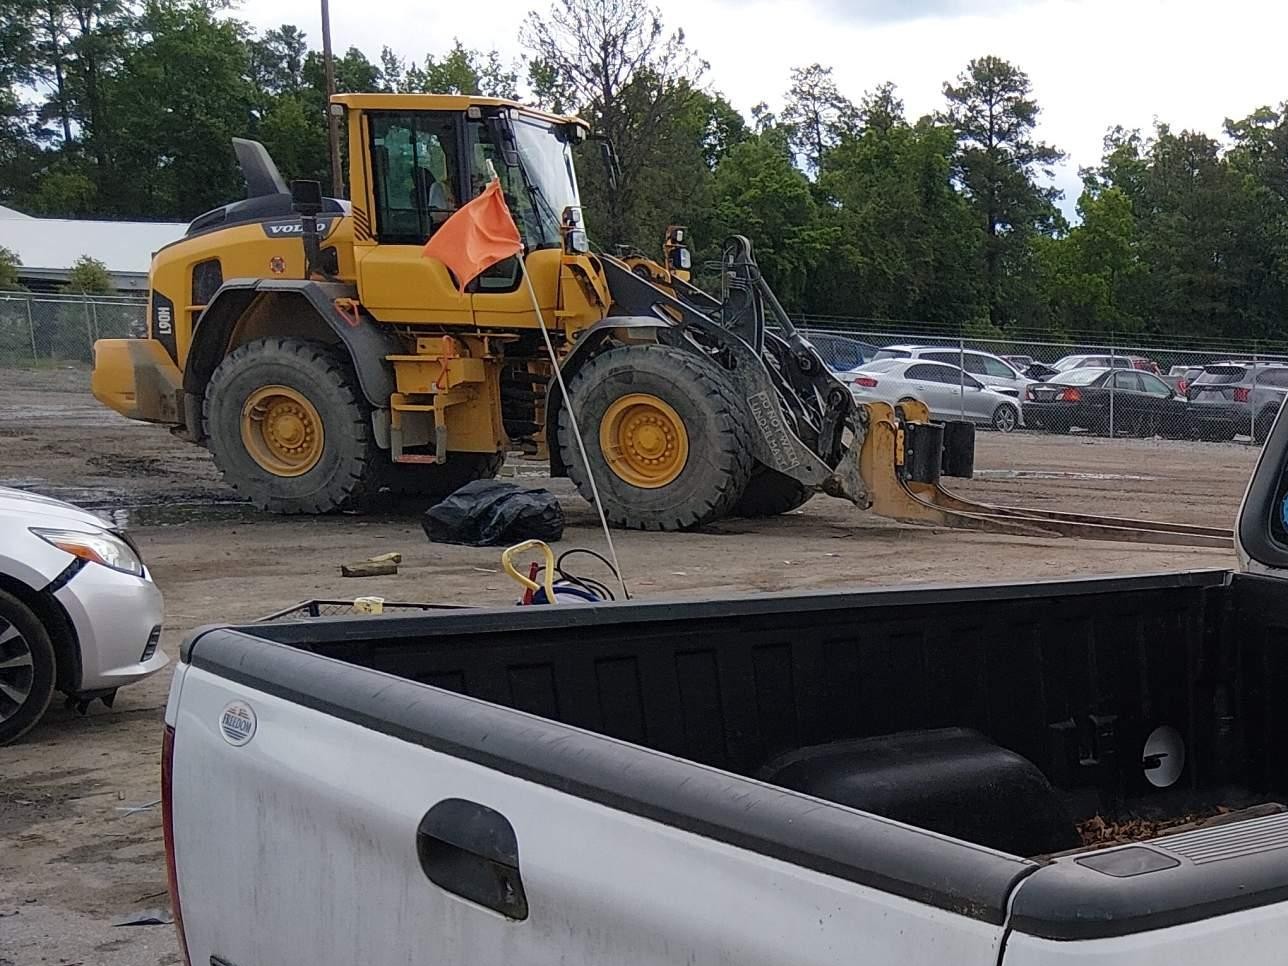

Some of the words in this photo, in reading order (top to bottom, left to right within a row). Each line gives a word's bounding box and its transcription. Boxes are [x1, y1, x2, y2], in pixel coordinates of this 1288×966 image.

[269, 223, 327, 234] VOLO
[157, 306, 173, 335] L90H
[222, 712, 252, 734] FREEDOM
